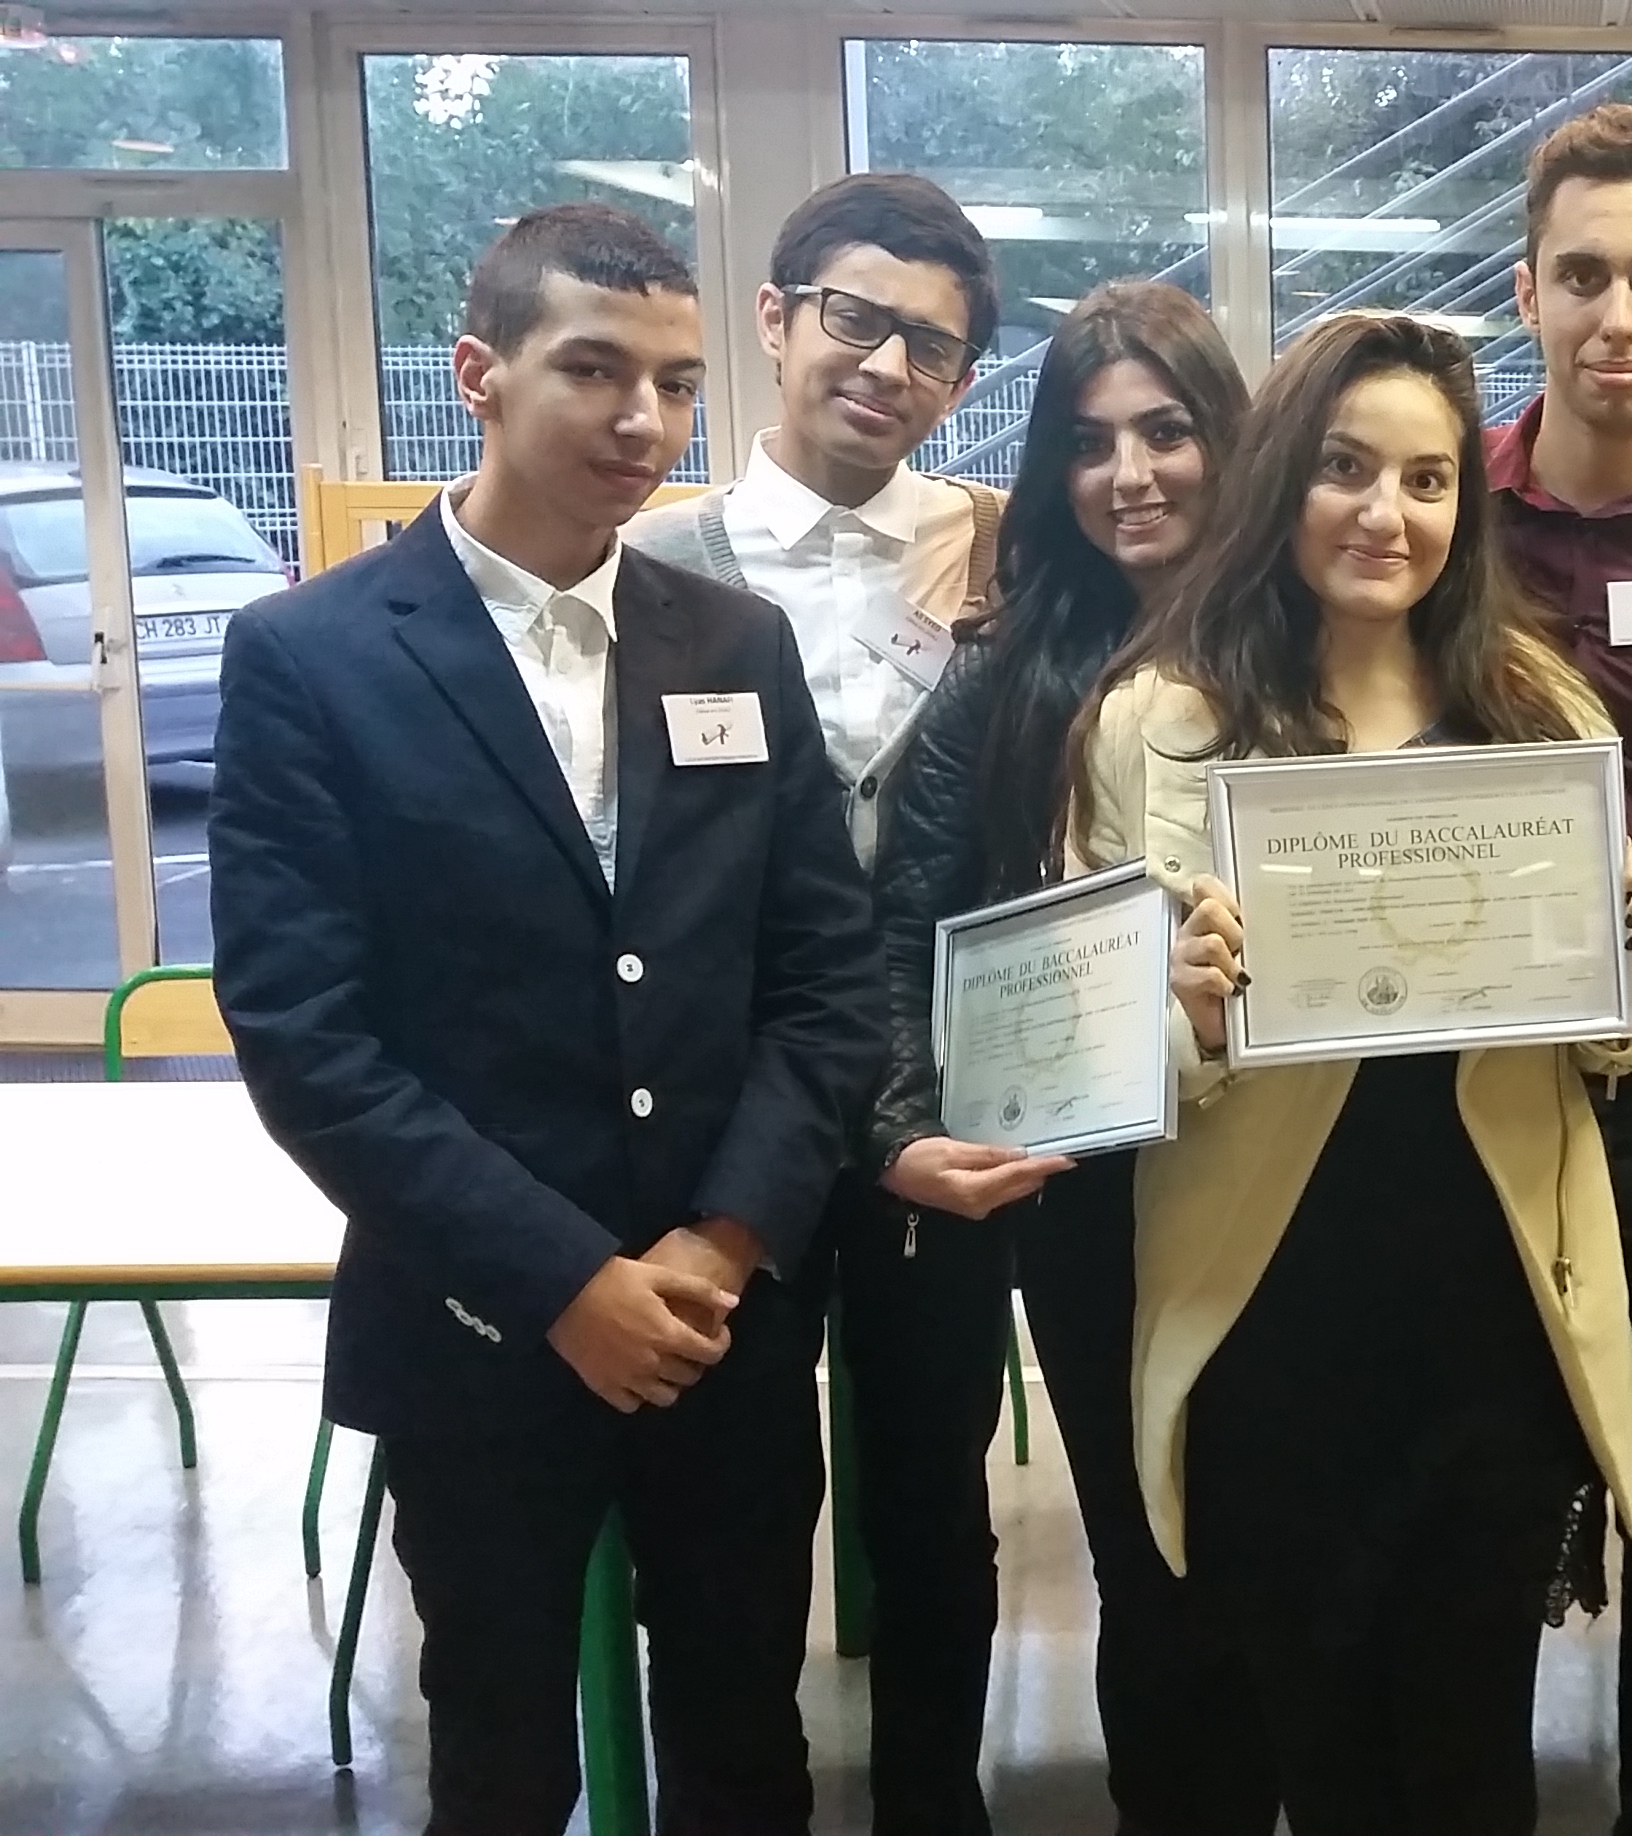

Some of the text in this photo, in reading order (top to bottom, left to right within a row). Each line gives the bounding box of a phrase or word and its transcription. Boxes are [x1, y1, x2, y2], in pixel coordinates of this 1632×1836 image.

[162, 617, 196, 637] 283
[1267, 816, 1575, 855] DIPLÔME DU BACCALAURÉAT
[1338, 843, 1500, 869] PROFESSIONNEL
[963, 963, 1012, 993] DIPLÔME
[1019, 959, 1036, 976] DU
[1042, 930, 1141, 970] BACCALAURÉAT
[1000, 962, 1093, 999] PROFESSIONNEL
